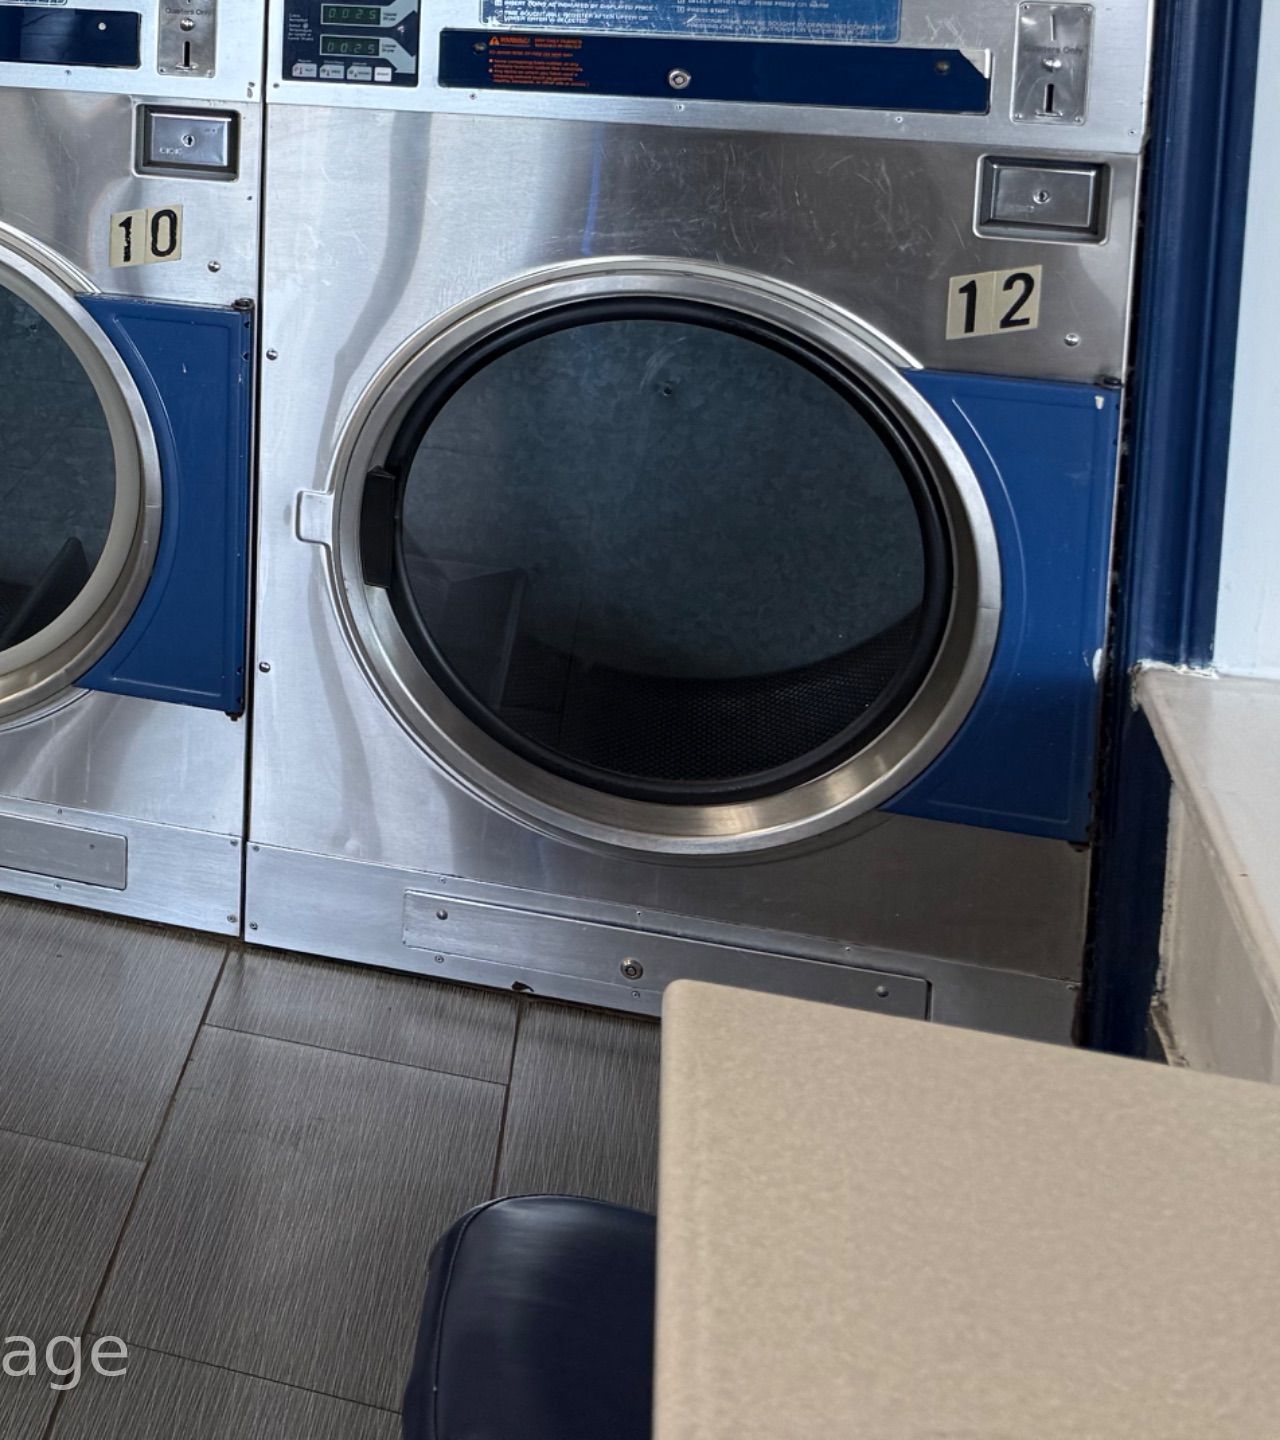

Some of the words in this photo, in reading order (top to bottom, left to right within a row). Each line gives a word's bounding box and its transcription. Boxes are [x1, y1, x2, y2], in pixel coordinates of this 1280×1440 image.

[328, 7, 377, 20] 0025
[327, 42, 375, 53] 0025
[118, 209, 178, 262] 10
[958, 272, 1035, 334] 12
